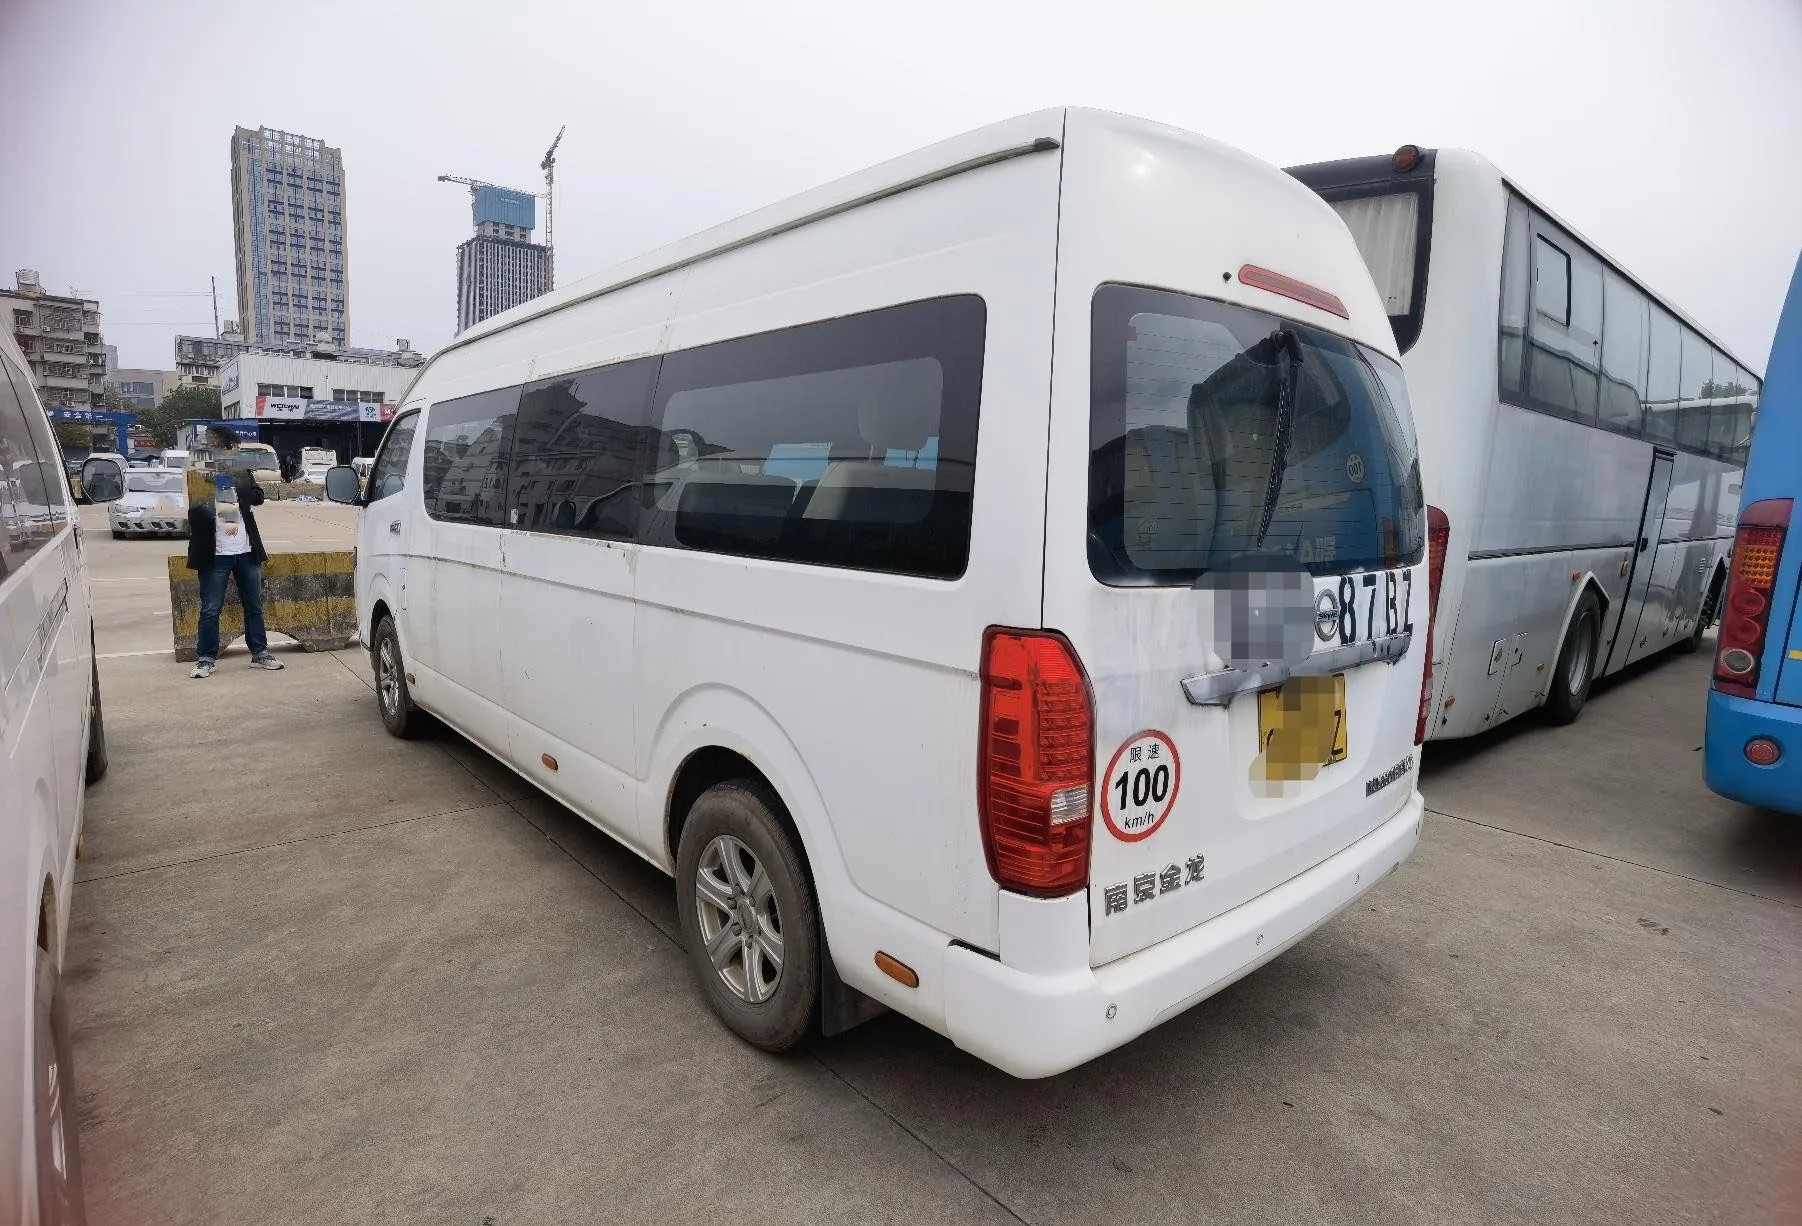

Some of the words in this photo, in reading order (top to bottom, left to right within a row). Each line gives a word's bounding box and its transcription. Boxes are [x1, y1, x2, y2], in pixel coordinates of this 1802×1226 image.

[1130, 743, 1159, 763] 限速
[1115, 764, 1169, 811] 100
[1124, 811, 1155, 829] km/h
[1104, 853, 1205, 916] 南京金龙
